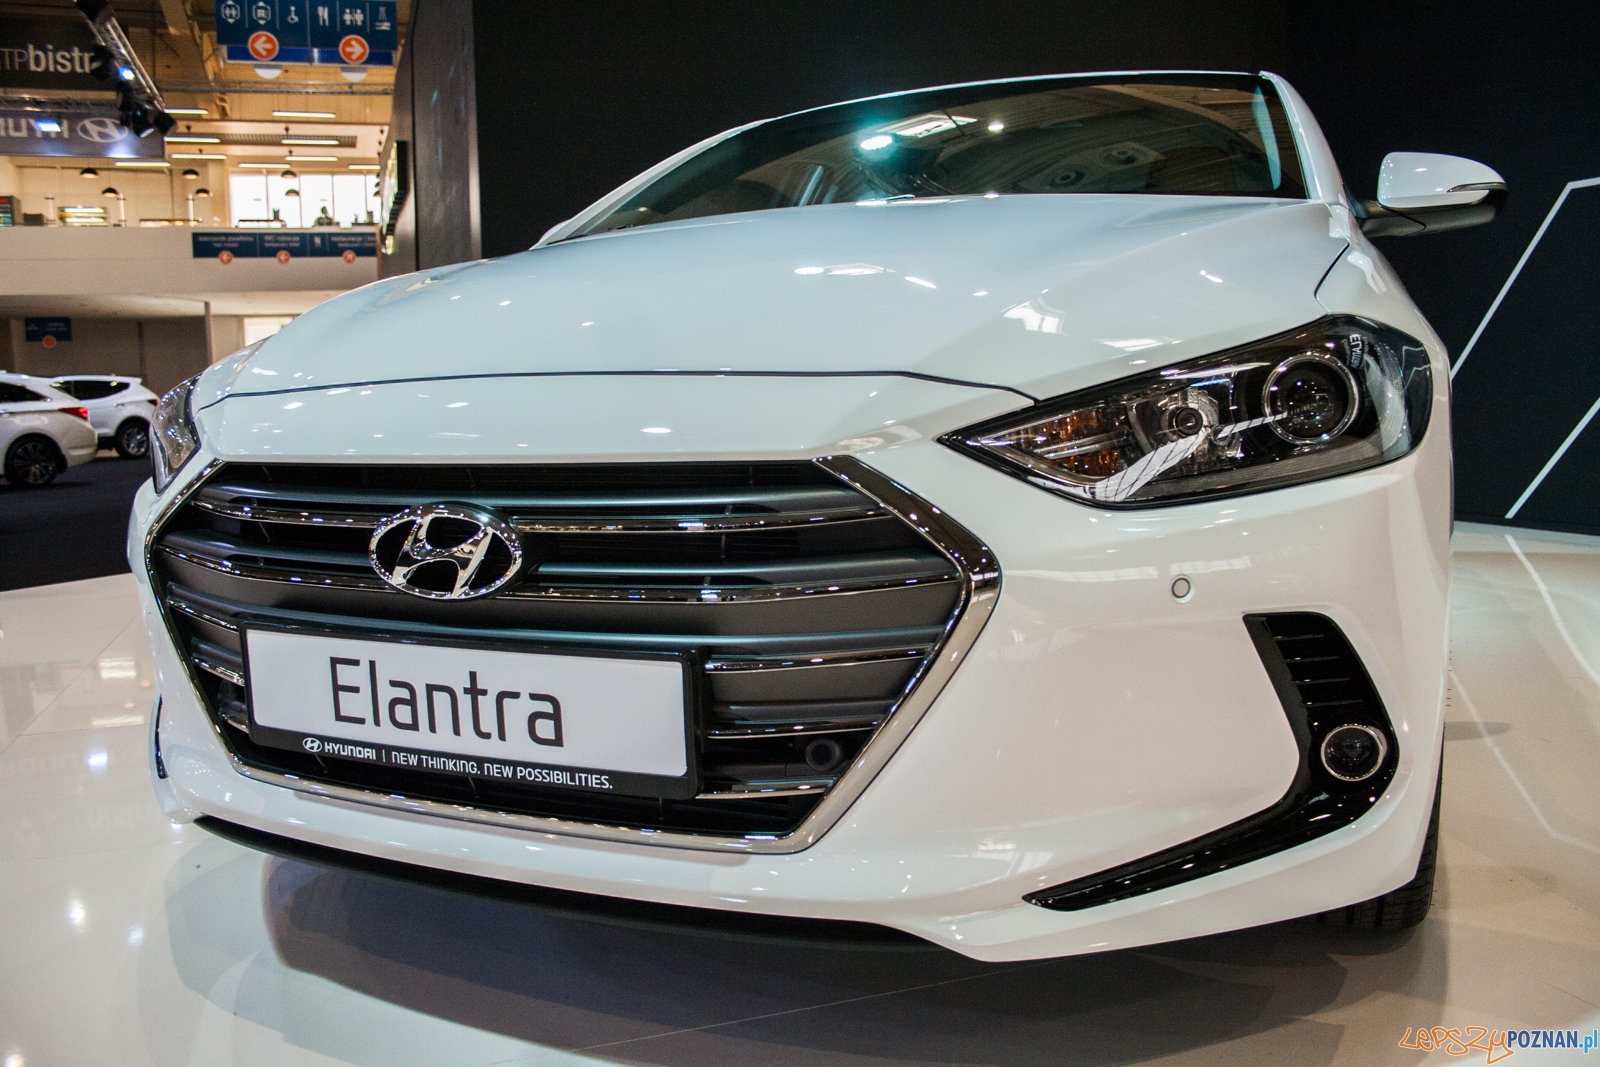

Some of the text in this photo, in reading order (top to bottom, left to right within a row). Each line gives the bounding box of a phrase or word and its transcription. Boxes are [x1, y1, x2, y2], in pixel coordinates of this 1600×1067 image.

[0, 44, 102, 73] TPbistr
[330, 656, 564, 748] Elantra
[324, 742, 613, 789] HYUNDAI NEW THINKING. NEW POSSIBILITIES.
